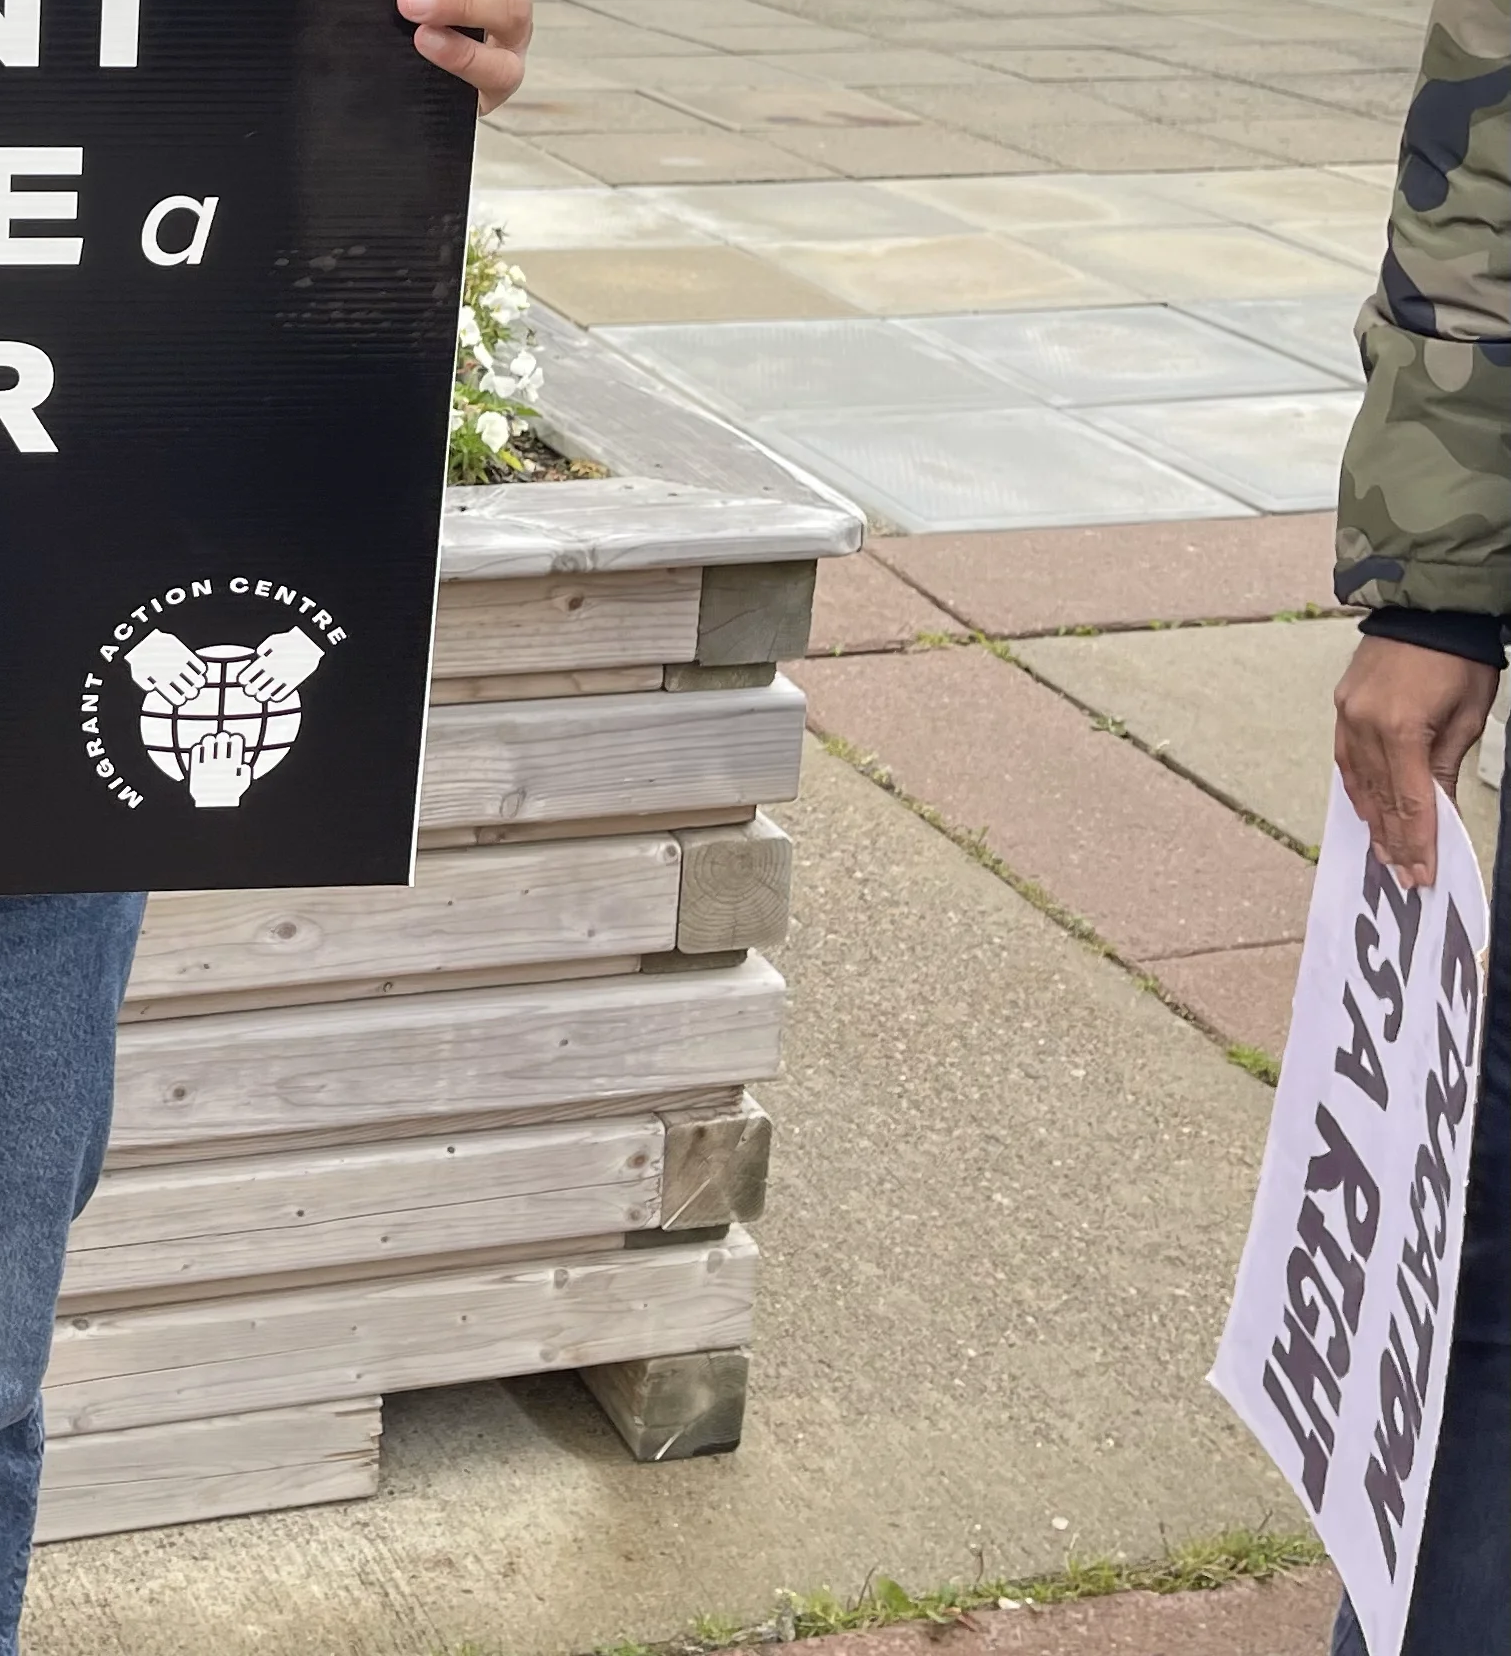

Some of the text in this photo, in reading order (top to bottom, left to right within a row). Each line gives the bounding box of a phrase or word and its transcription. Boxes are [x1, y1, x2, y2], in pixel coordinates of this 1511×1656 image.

[142, 194, 219, 266] a
[81, 577, 347, 808] MIGRANT ACTION CENTRE
[1262, 1101, 1380, 1513] RIGHT
[1365, 892, 1478, 1584] EDUCATION
